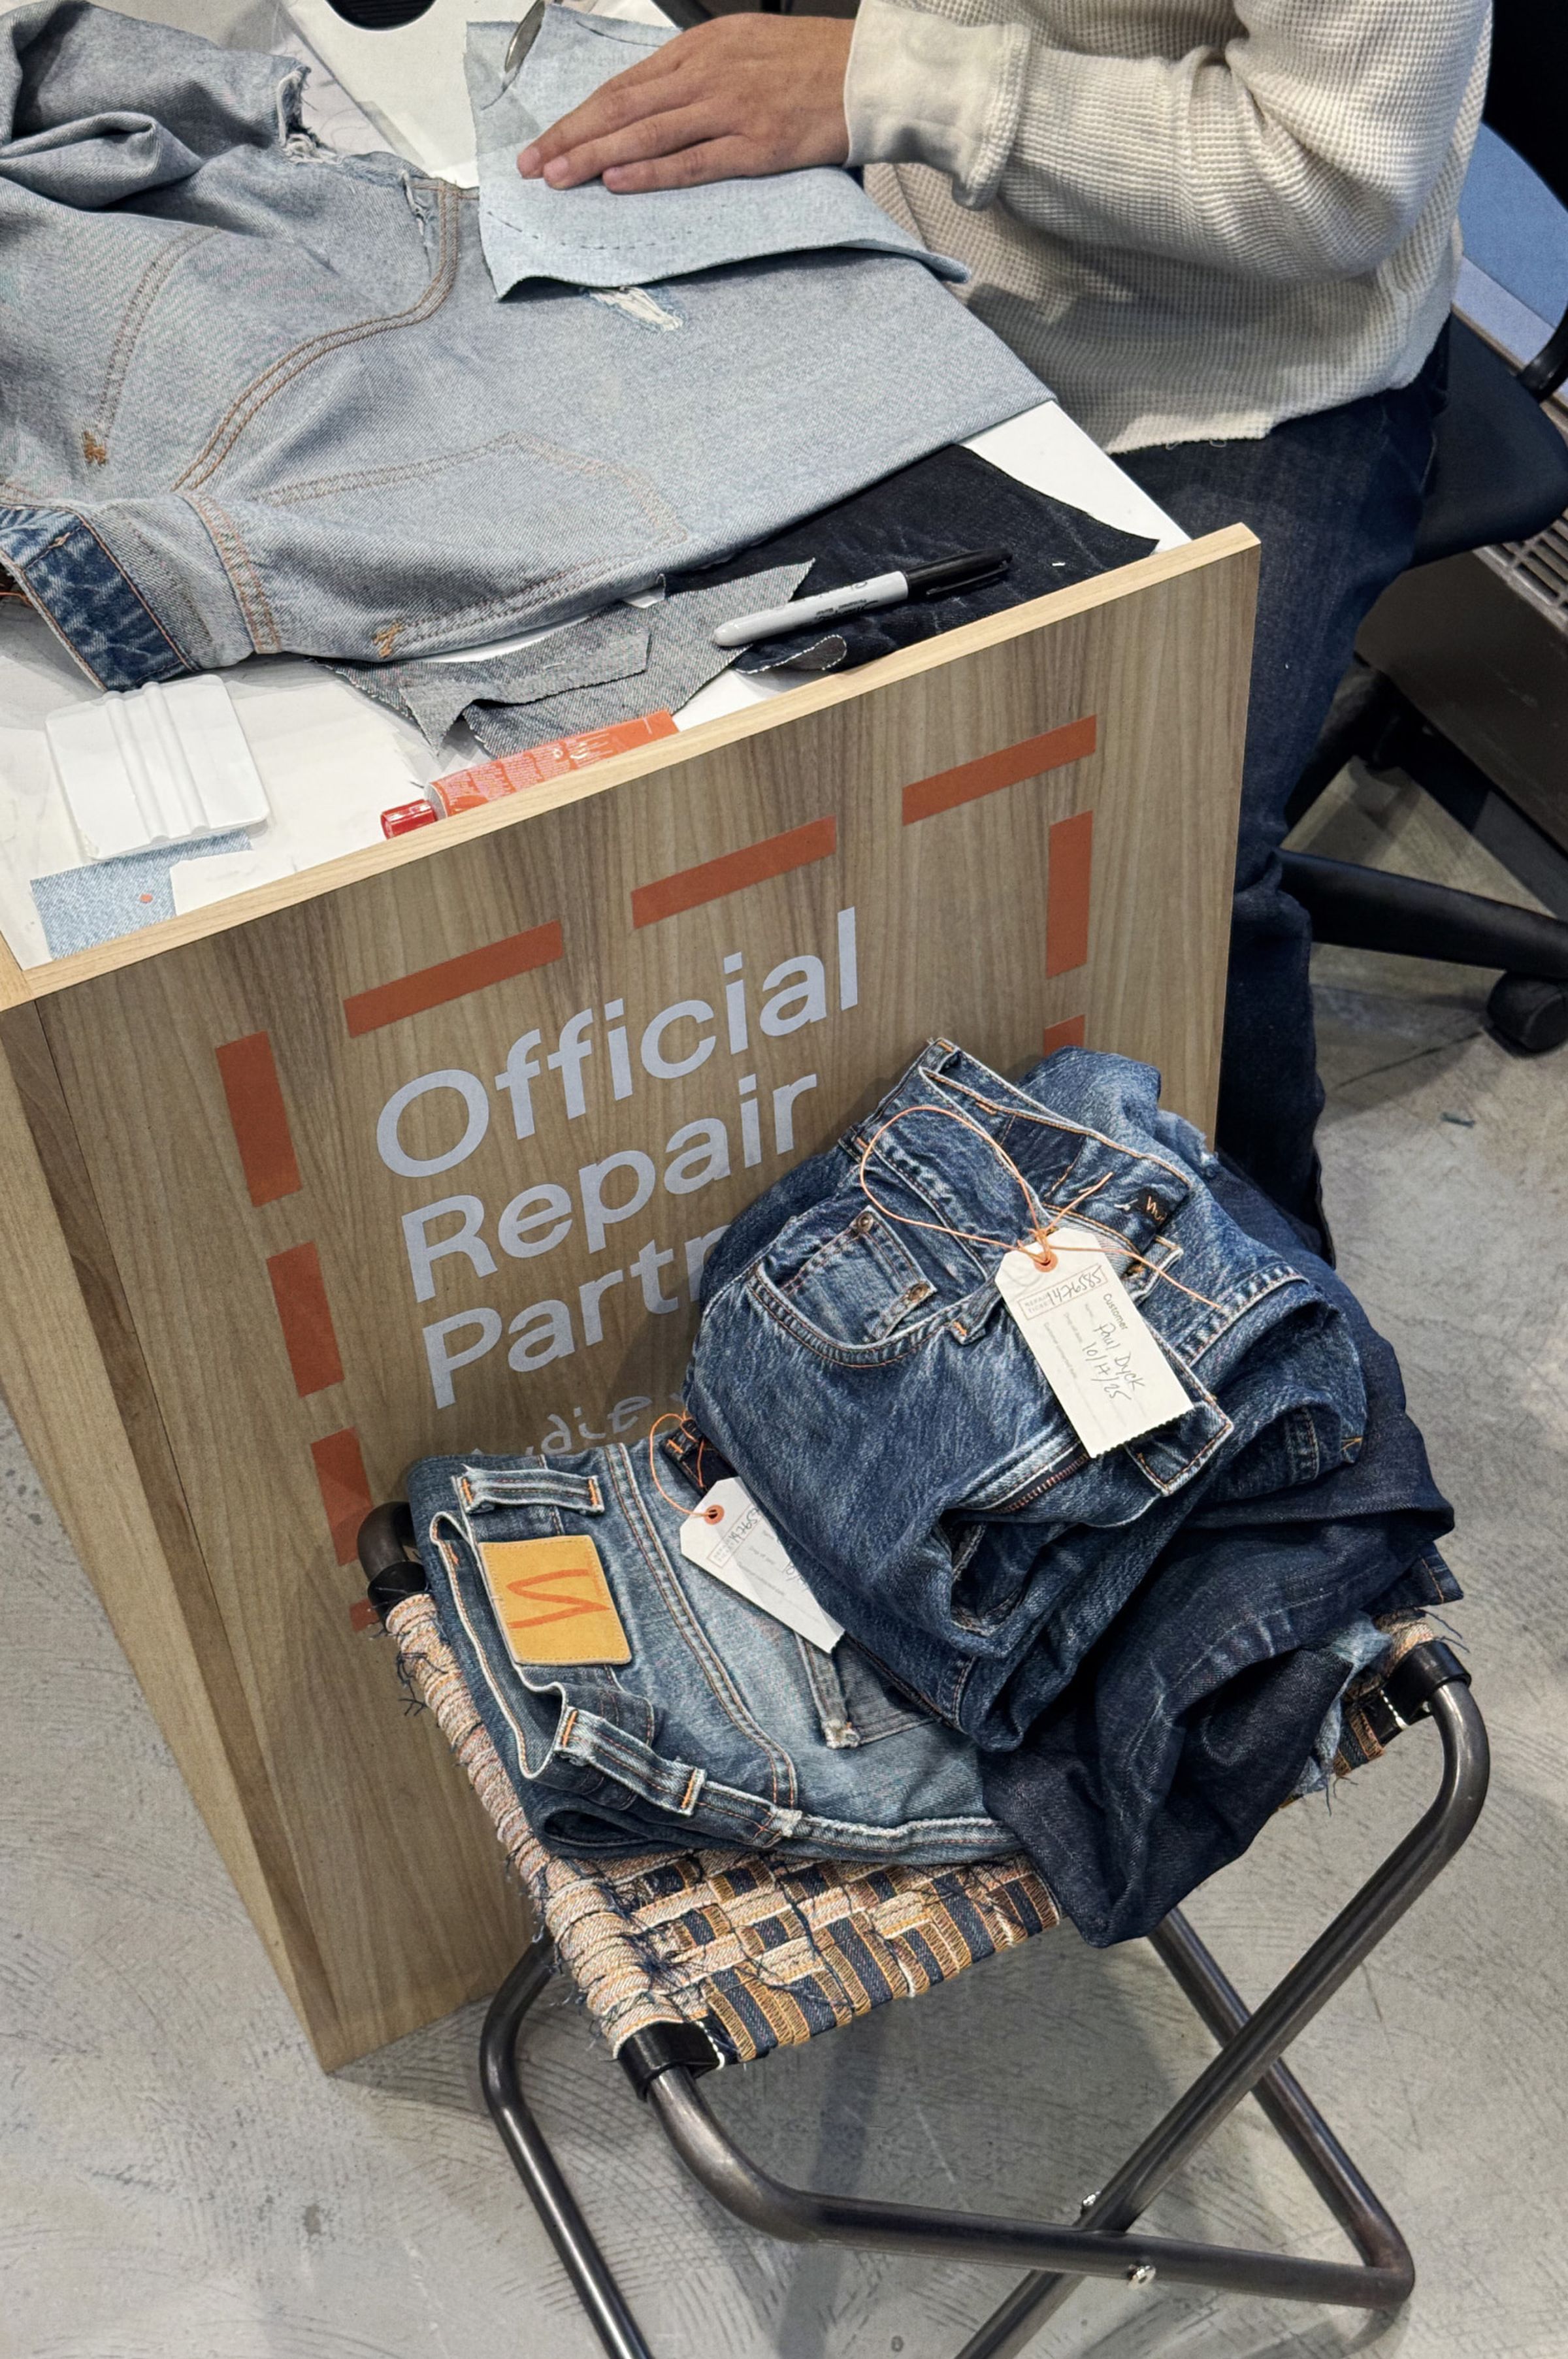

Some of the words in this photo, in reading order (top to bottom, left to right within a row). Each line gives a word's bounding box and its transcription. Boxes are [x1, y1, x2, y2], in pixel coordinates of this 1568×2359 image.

[376, 907, 858, 1177] Official
[401, 1074, 817, 1303] Repair
[422, 1224, 732, 1409] Partn
[1093, 1322, 1120, 1350] Paul
[1103, 1293, 1128, 1330] Customer
[472, 1395, 652, 1456] die
